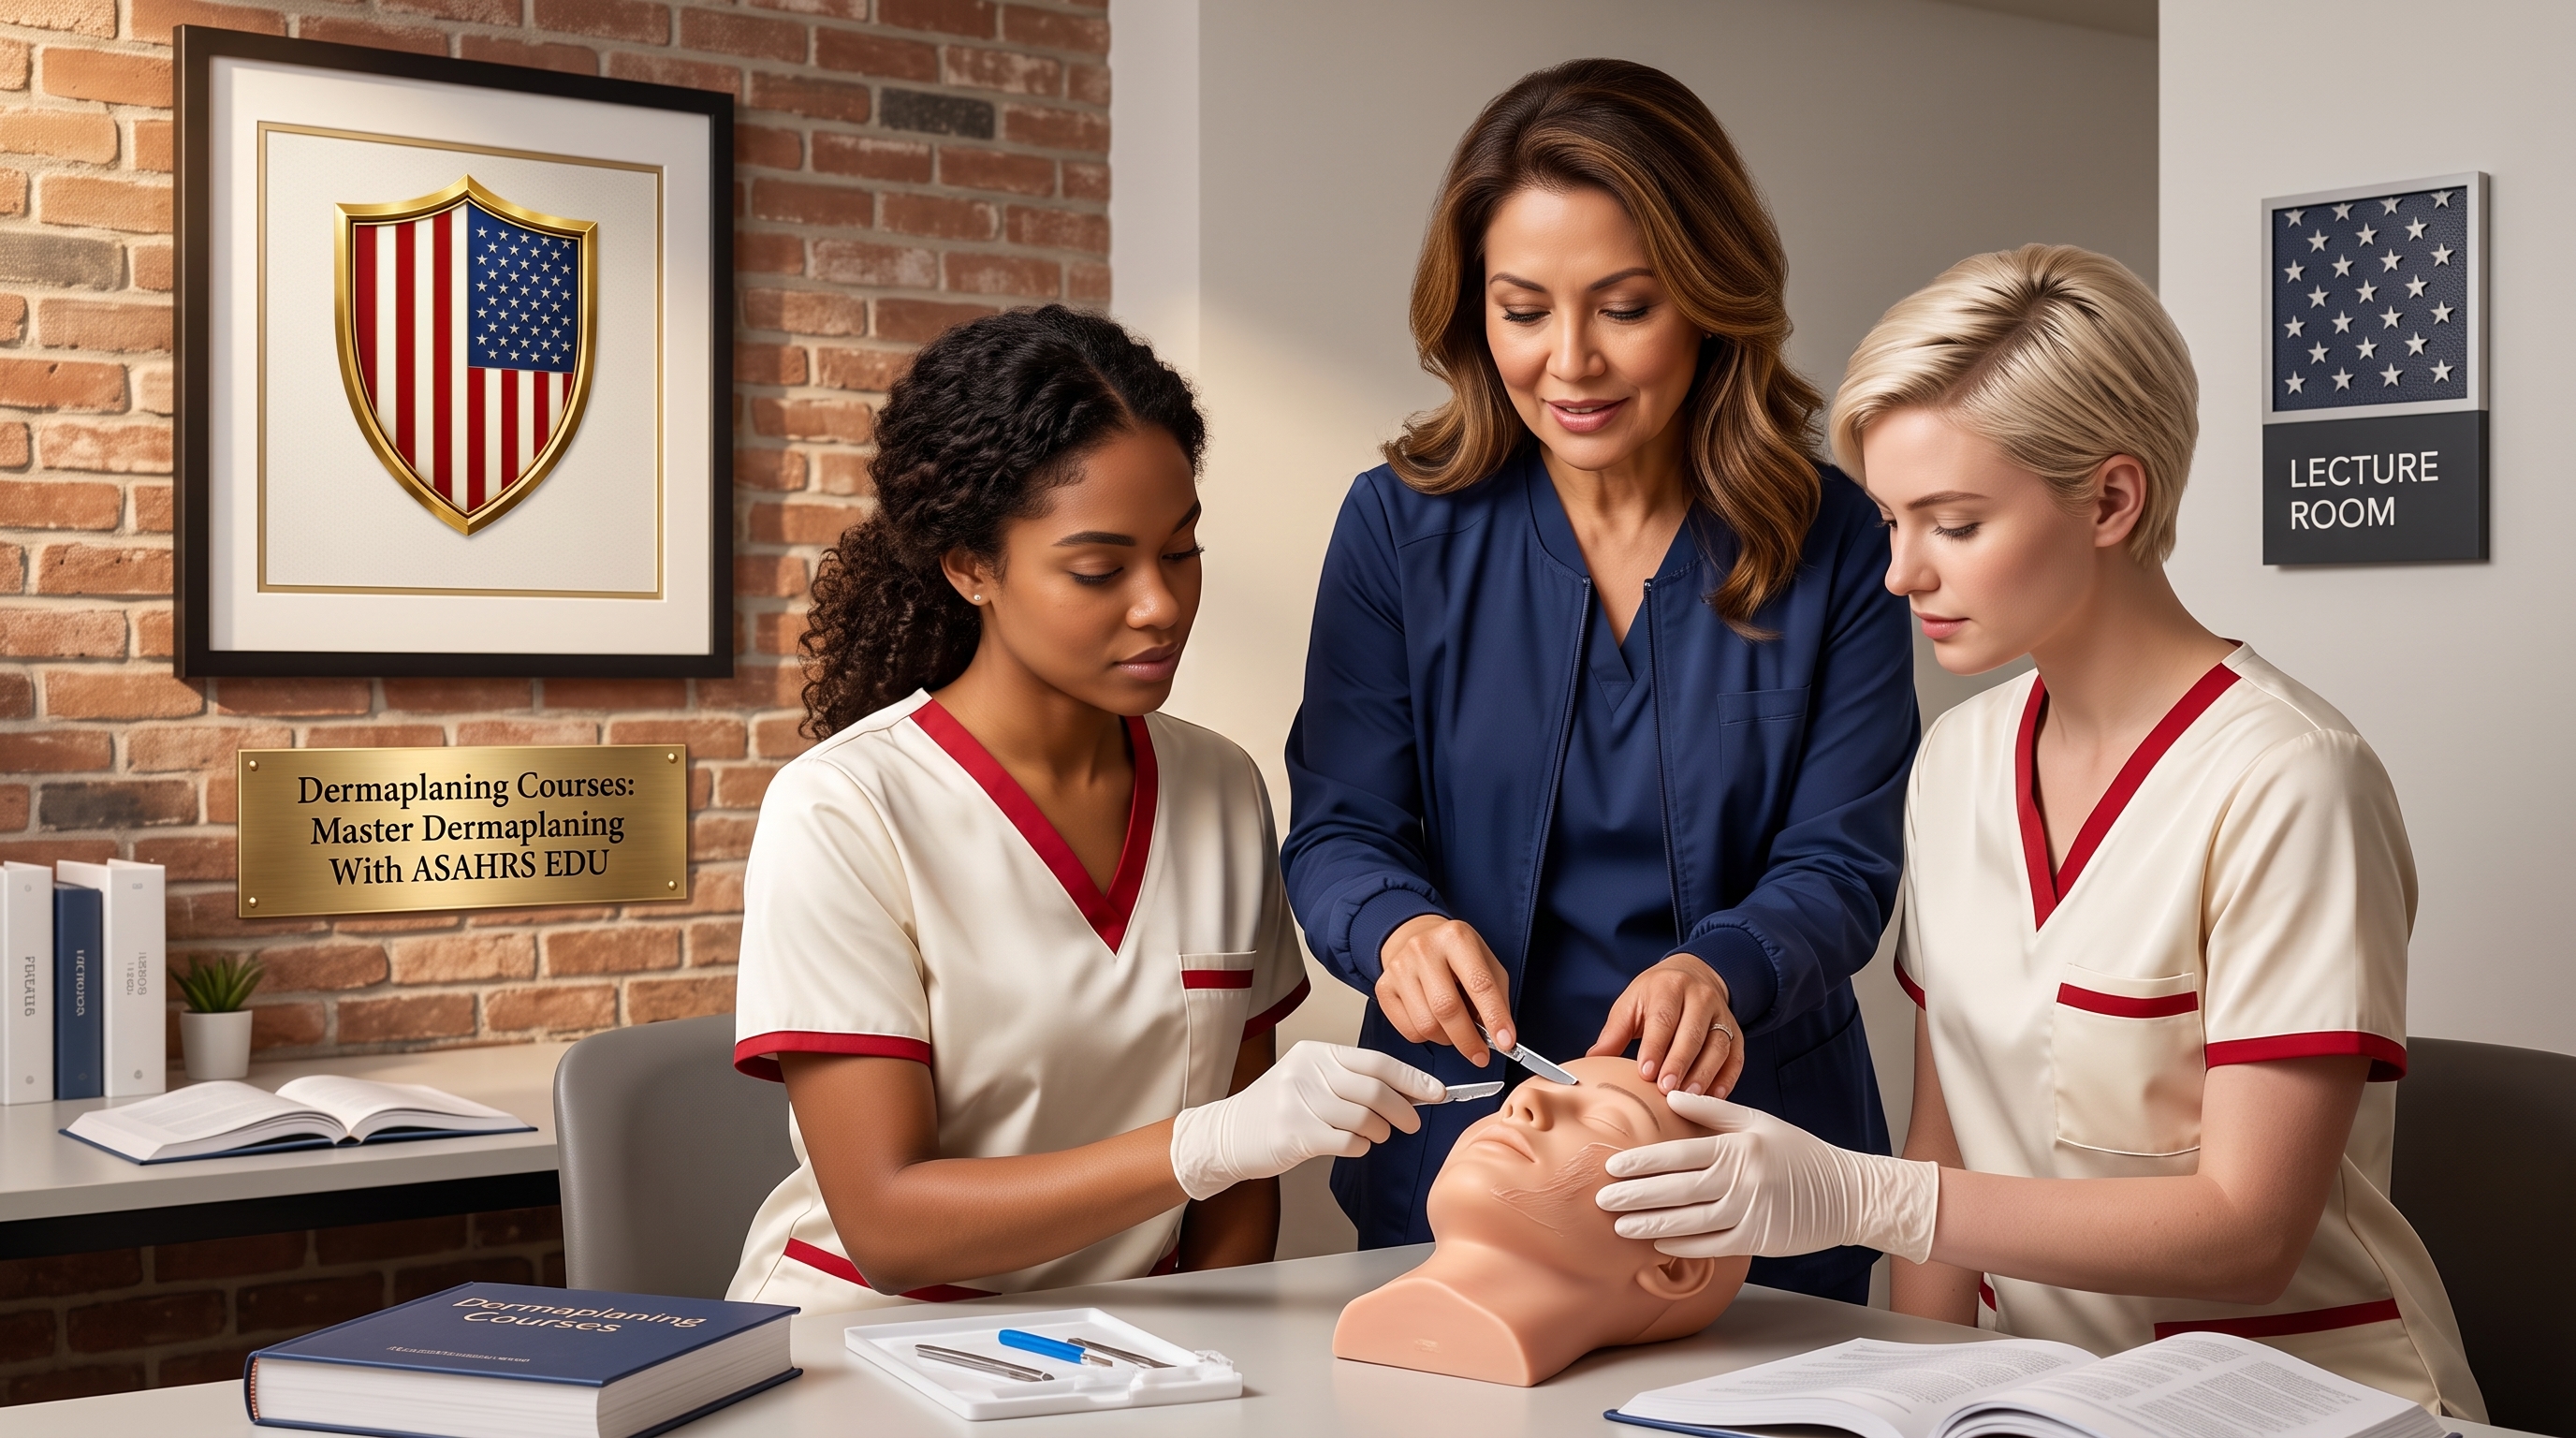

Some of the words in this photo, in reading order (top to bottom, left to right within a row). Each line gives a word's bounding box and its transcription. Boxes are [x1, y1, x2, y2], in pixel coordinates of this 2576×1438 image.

[2291, 450, 2438, 488] LECTURE
[2291, 496, 2394, 530] ROOM
[298, 772, 509, 809] Dermaplaning
[517, 770, 635, 800] Courses:
[311, 816, 414, 844] Master
[421, 810, 624, 845] Dermaplaning
[329, 855, 402, 886] With
[411, 851, 536, 883] ASAHRS
[545, 849, 610, 877] EDU
[452, 1298, 707, 1328] Dermaplaning
[463, 1312, 622, 1332] Courses
